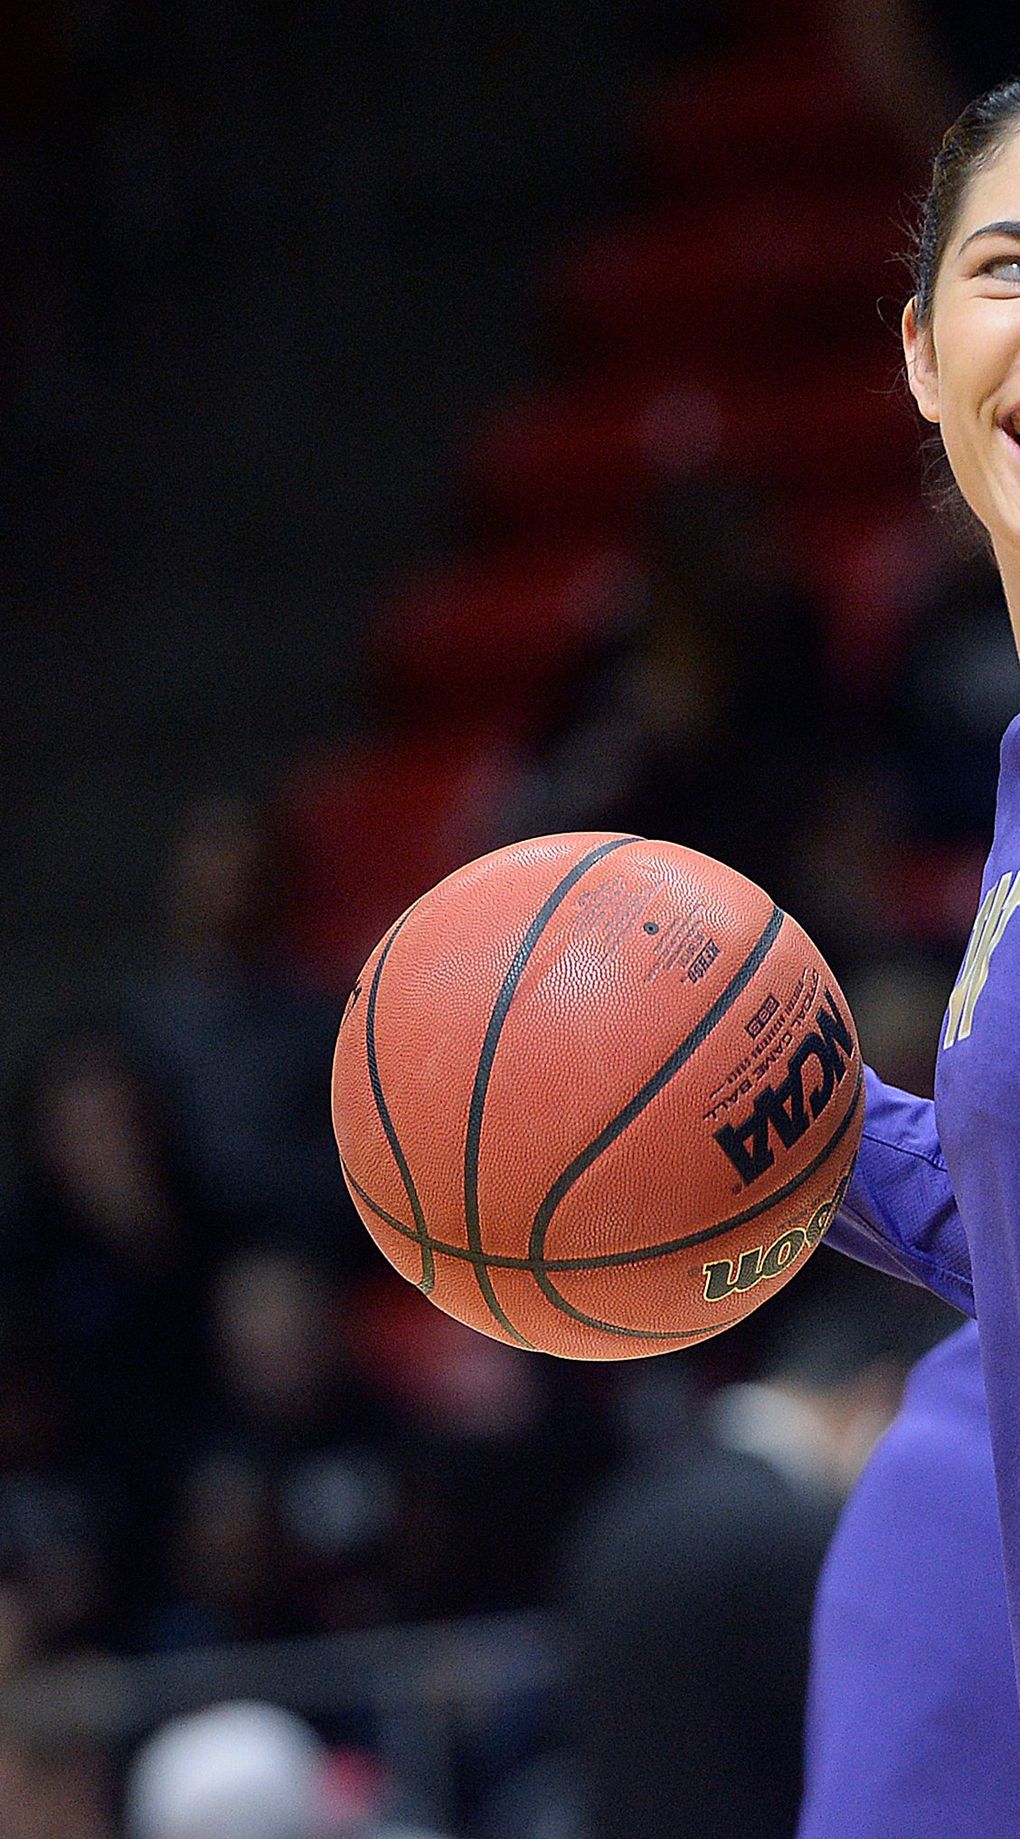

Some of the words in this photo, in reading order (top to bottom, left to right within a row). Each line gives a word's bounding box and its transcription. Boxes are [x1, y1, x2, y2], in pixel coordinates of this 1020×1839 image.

[747, 996, 778, 1035] 28.5
[751, 1030, 793, 1081] GAME
[704, 1078, 752, 1119] BALL
[711, 987, 852, 1187] NCAA
